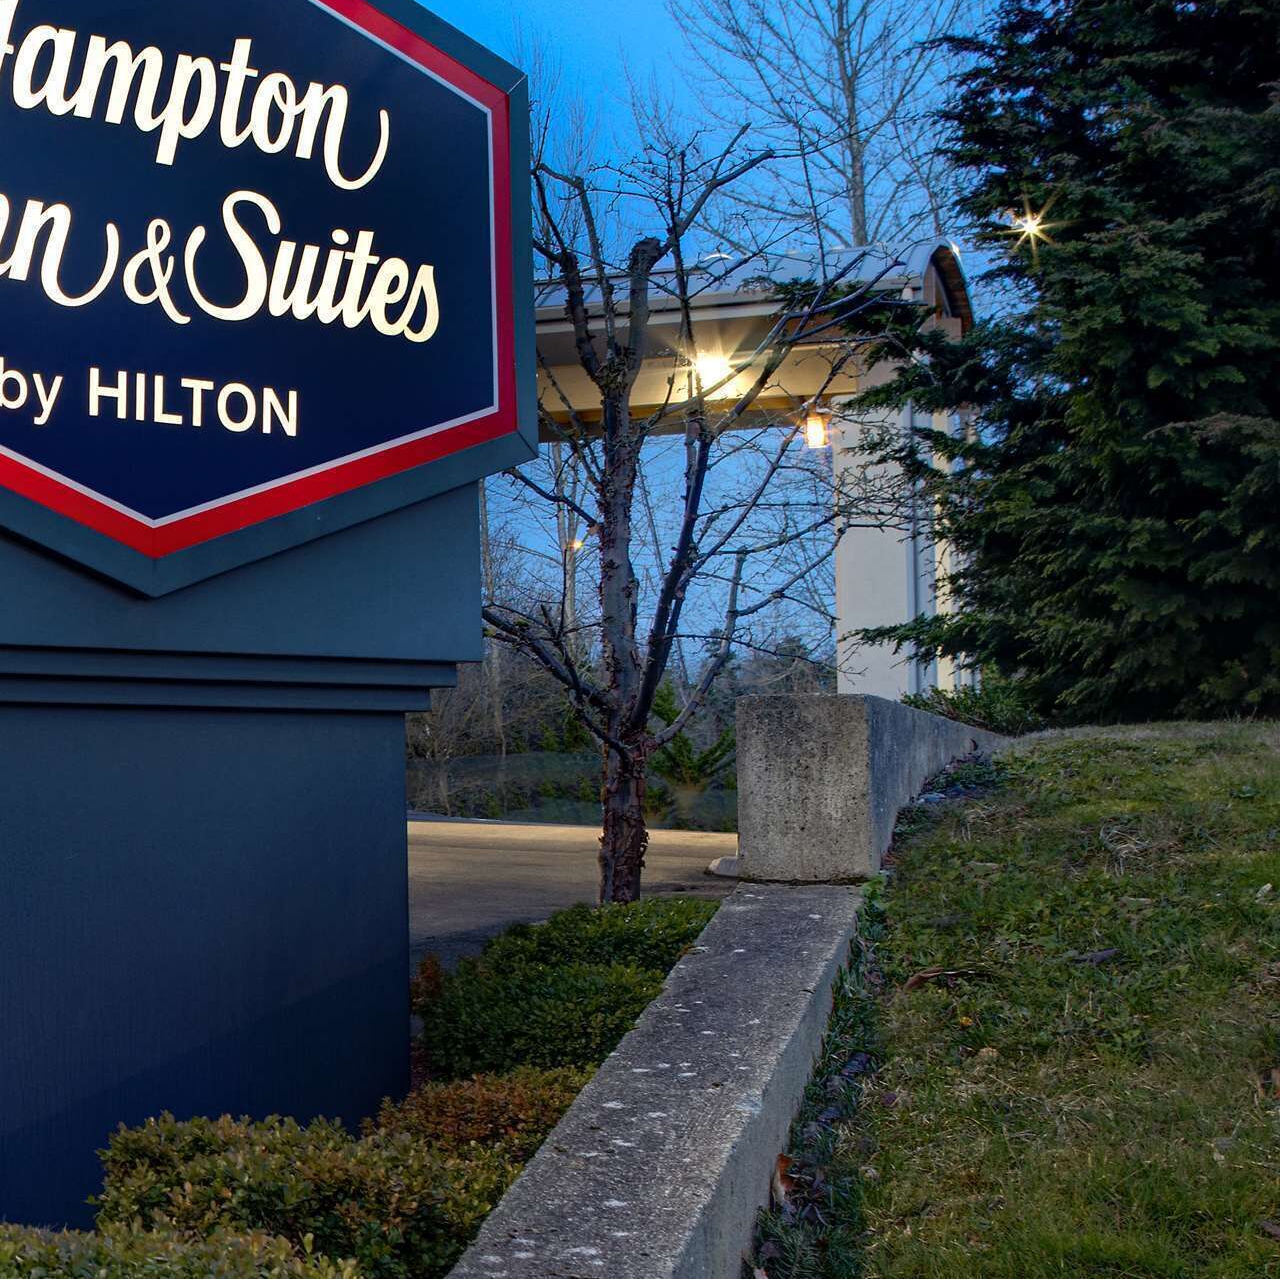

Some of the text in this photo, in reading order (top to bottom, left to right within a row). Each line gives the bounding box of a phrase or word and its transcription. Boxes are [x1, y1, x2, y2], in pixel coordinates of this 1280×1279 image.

[122, 217, 191, 326] &
[183, 189, 440, 344] Suites
[87, 366, 299, 438] HILTON
